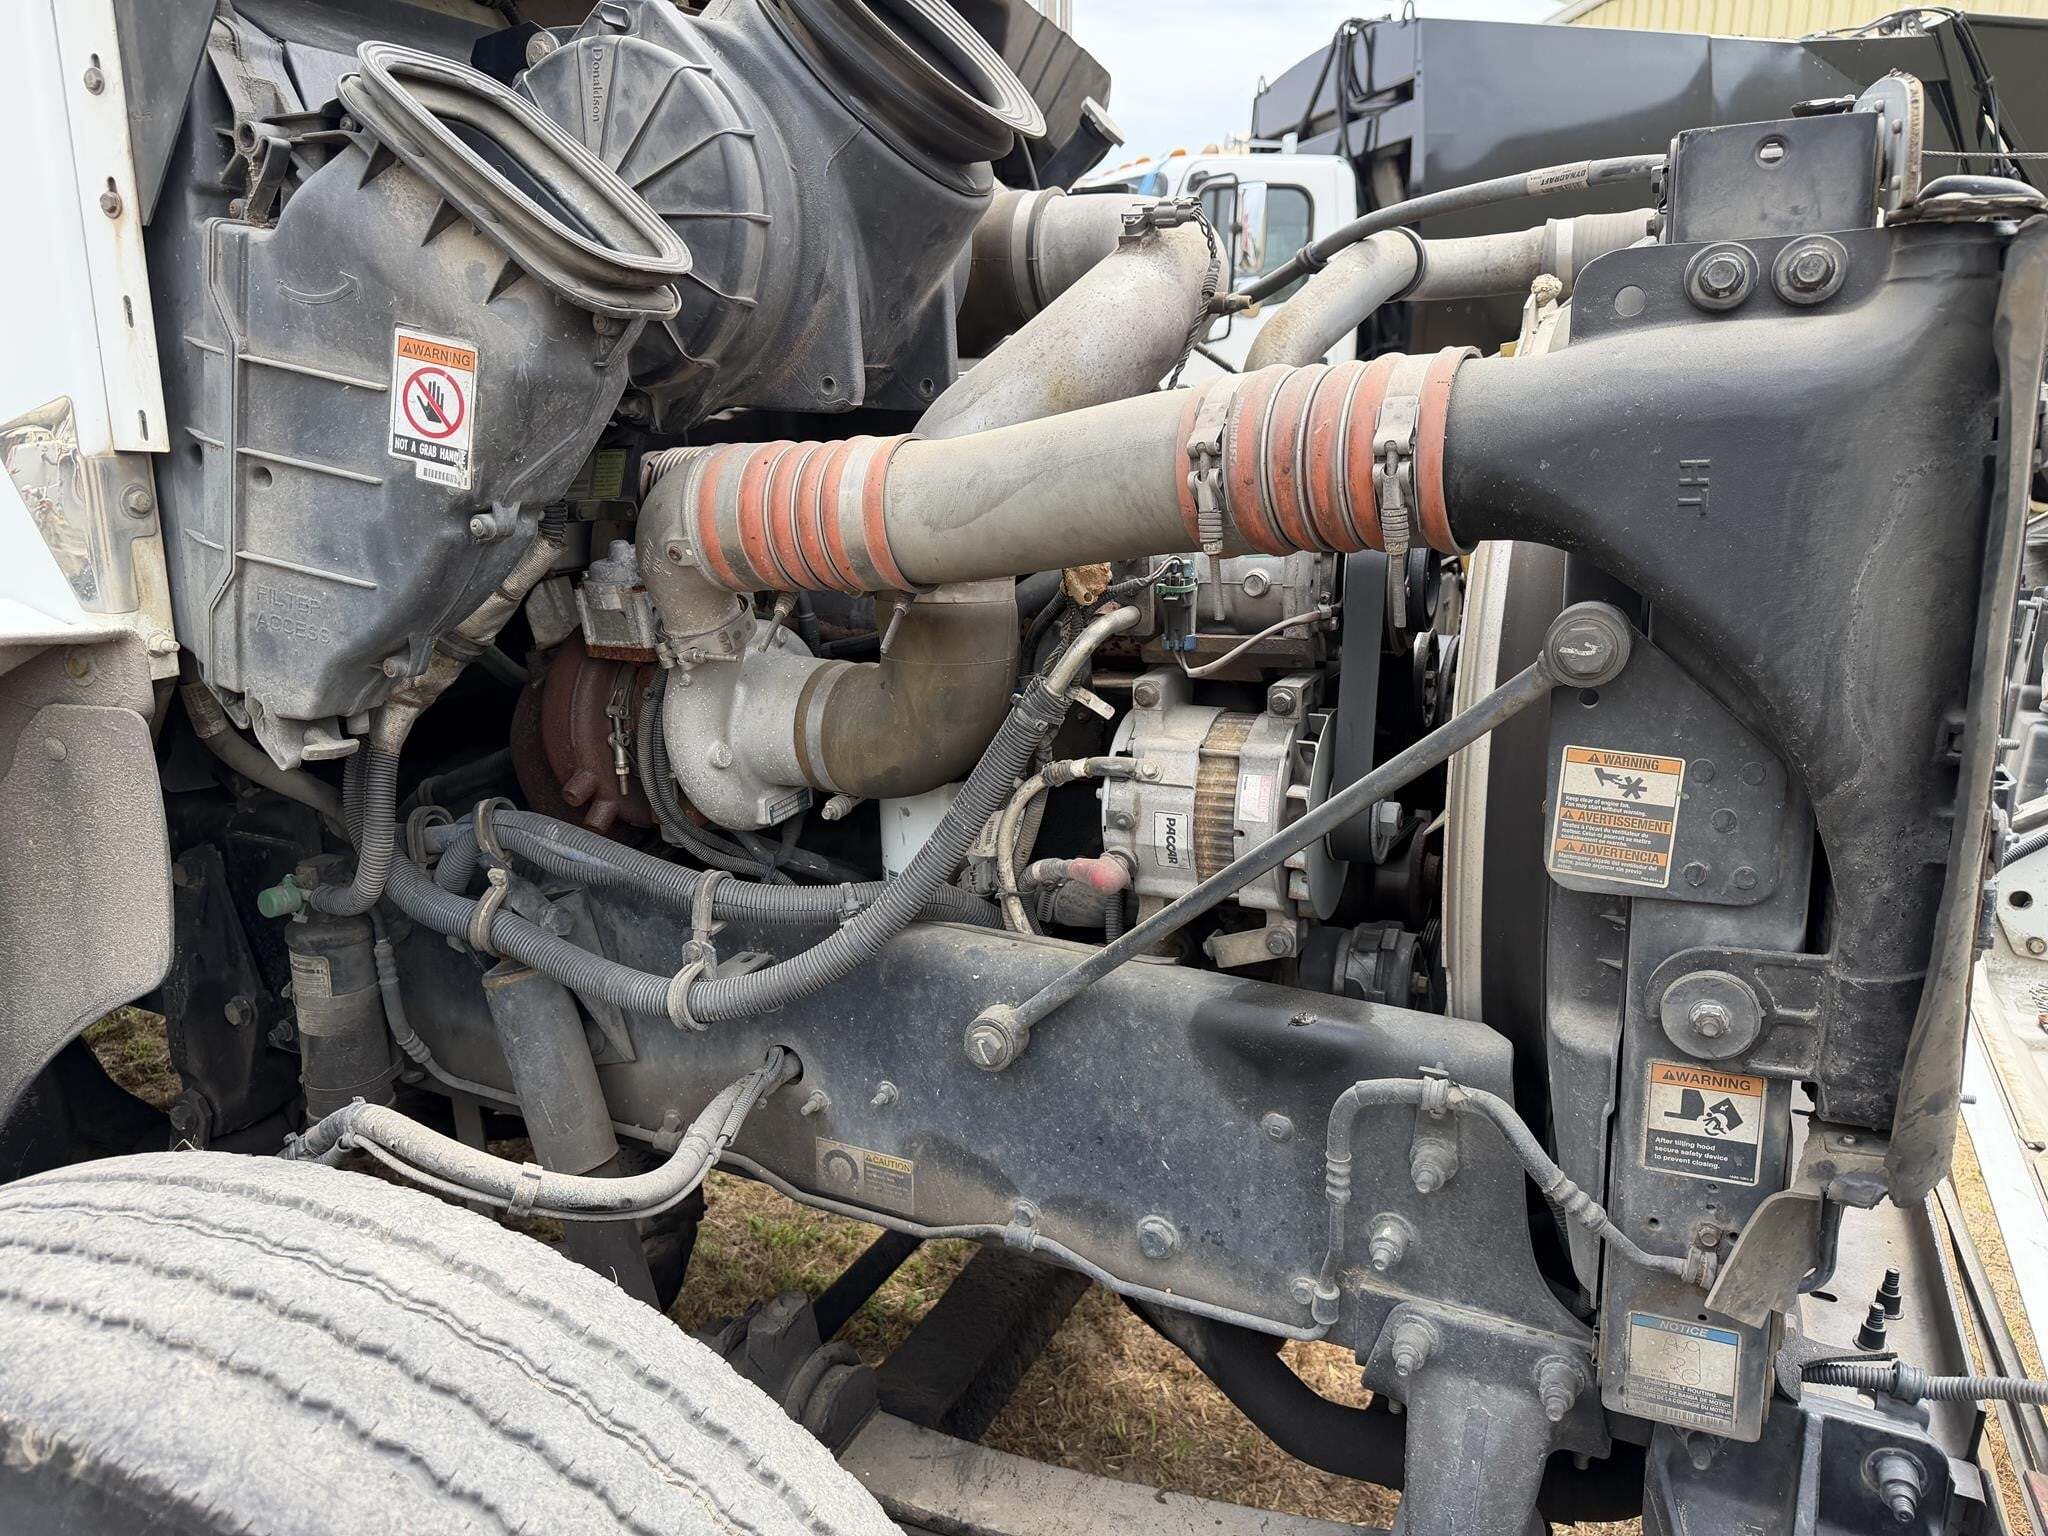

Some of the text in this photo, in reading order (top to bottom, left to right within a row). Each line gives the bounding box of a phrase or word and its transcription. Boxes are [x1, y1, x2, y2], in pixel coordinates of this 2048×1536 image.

[592, 48, 604, 122] Donaldson
[1540, 169, 1586, 186] DYNACRAFT
[413, 343, 470, 366] WARNING
[395, 436, 408, 451] NOT
[411, 441, 416, 453] A
[420, 443, 437, 458] GRAB
[257, 585, 320, 614] FILTER
[256, 611, 330, 644] ACCESS
[1603, 754, 1659, 771] WARNING
[1578, 811, 1671, 832] AVERTISSEMENT
[1166, 817, 1178, 865] PACCAR
[1580, 844, 1660, 864] ADVERTENCIA
[1676, 1072, 1751, 1091] WARNING
[1655, 1136, 1716, 1152] After tilting hood
[872, 1155, 911, 1172] CAUTION
[1654, 1146, 1728, 1162] secure safety device
[1662, 1155, 1690, 1164] prevent
[1692, 1160, 1720, 1170] closing.
[1660, 1320, 1710, 1338] NOTICE
[1670, 1382, 1686, 1391] BELT
